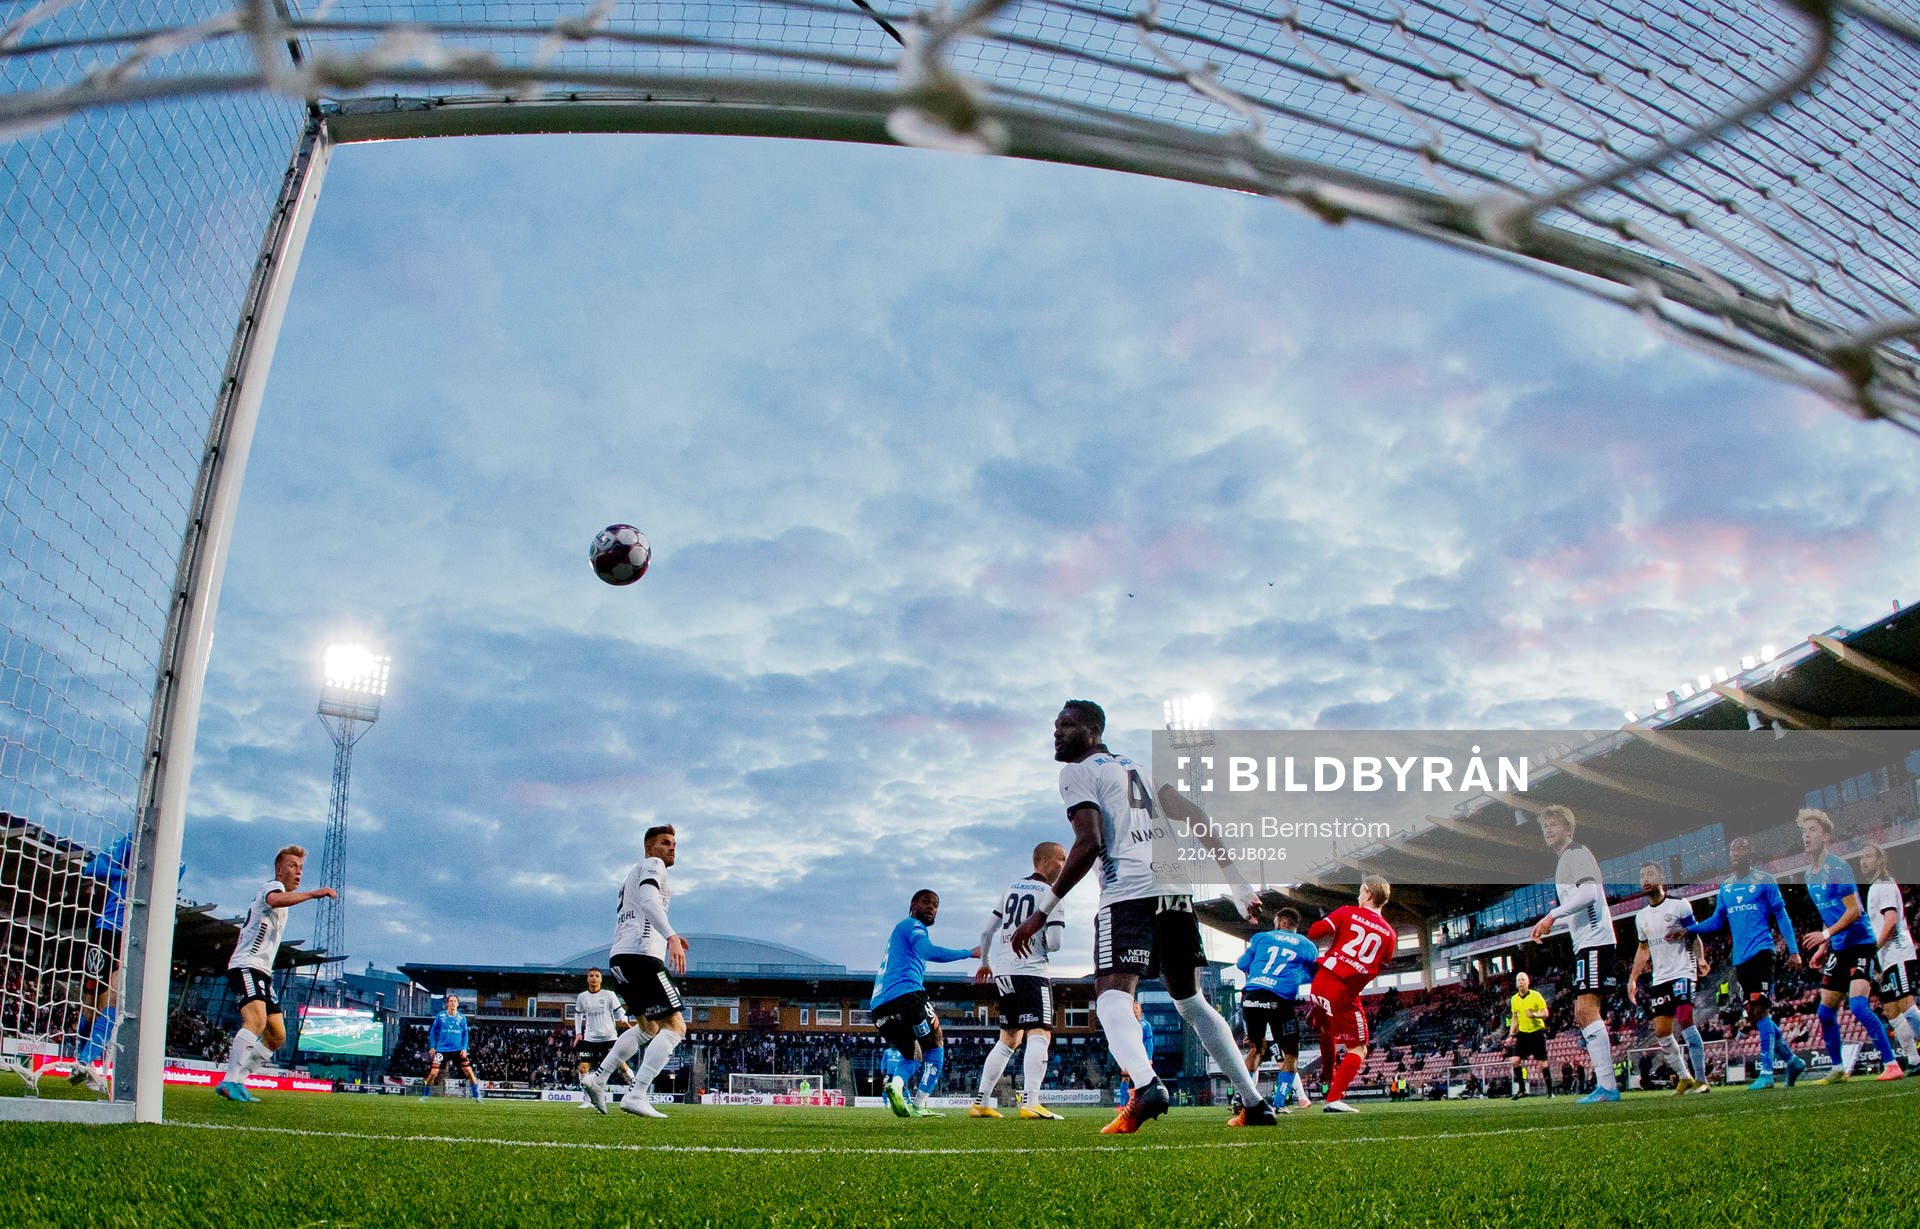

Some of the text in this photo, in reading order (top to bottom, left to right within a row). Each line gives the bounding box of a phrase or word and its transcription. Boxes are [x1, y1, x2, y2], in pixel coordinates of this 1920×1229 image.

[1127, 769, 1159, 819] 4
[1003, 893, 1035, 929] 90
[1262, 945, 1298, 976] 17
[1341, 923, 1382, 964] 20
